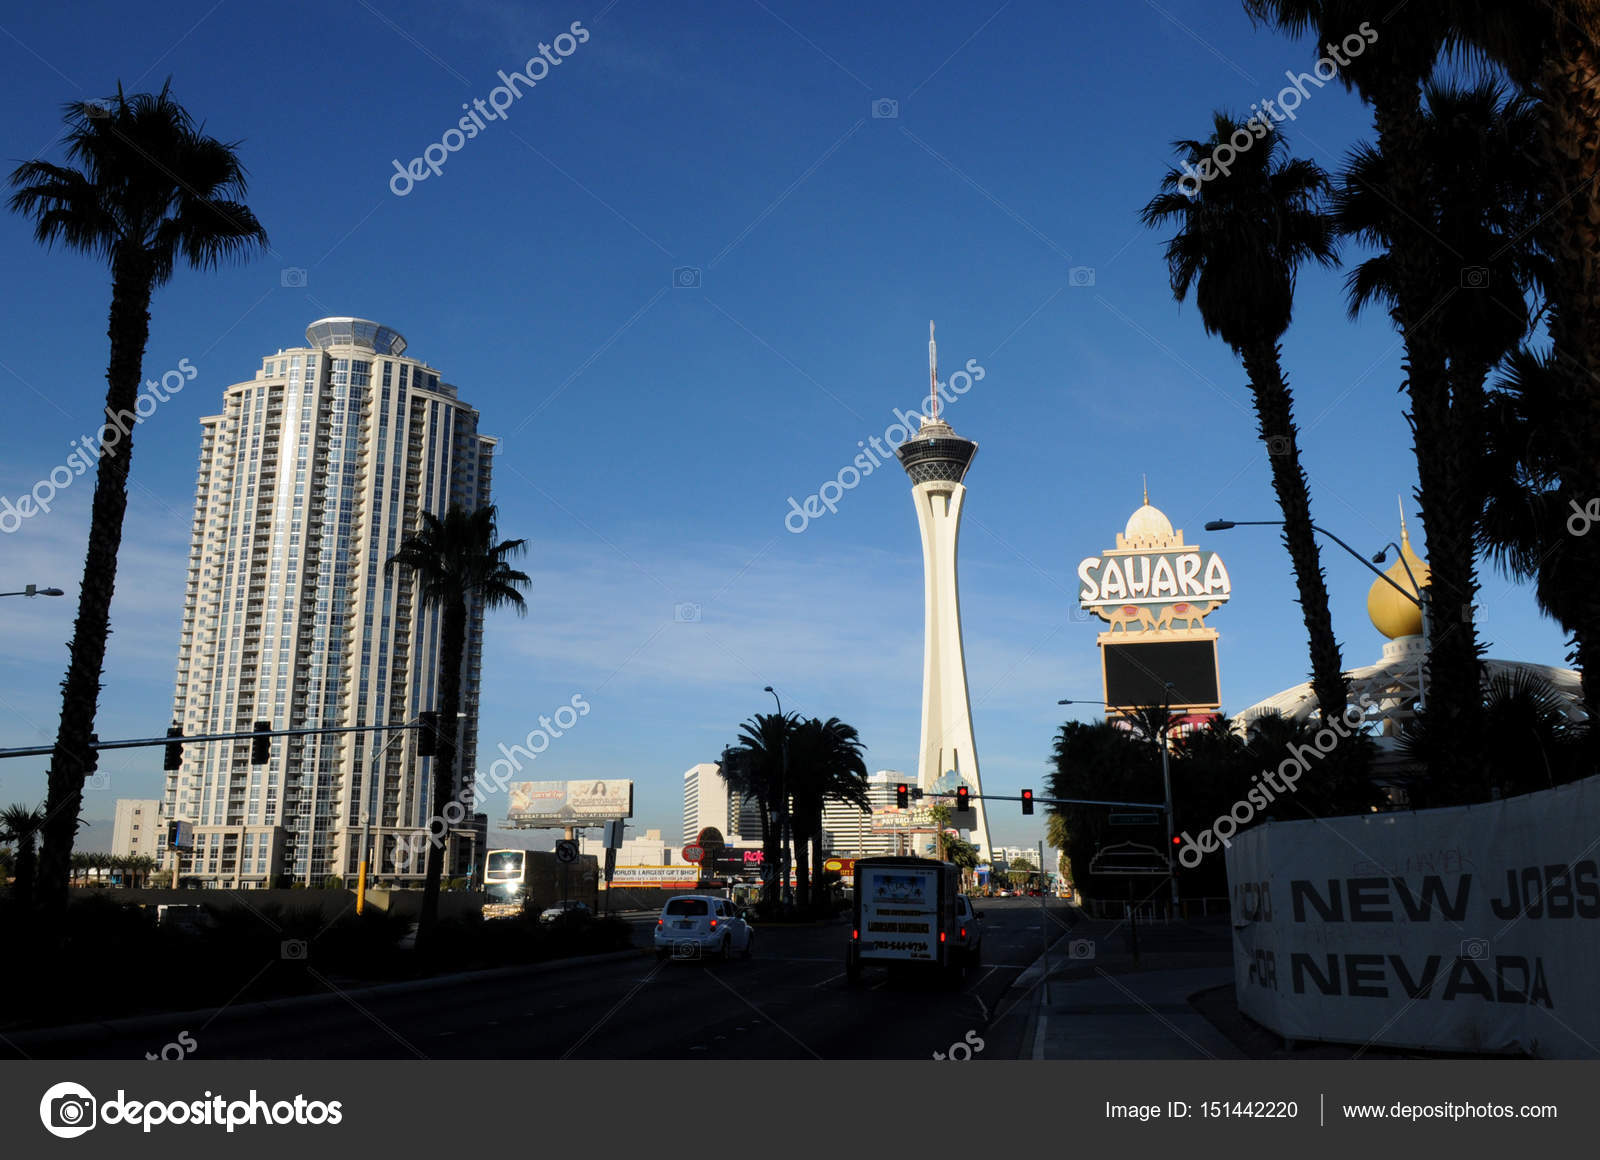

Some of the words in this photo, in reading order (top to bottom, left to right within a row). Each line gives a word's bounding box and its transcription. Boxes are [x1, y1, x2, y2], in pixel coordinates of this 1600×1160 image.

[1077, 552, 1232, 601] SAHARA
[1291, 874, 1473, 922] NEW
[1490, 860, 1600, 921] JOBS
[1291, 953, 1554, 1010] NEVADA
